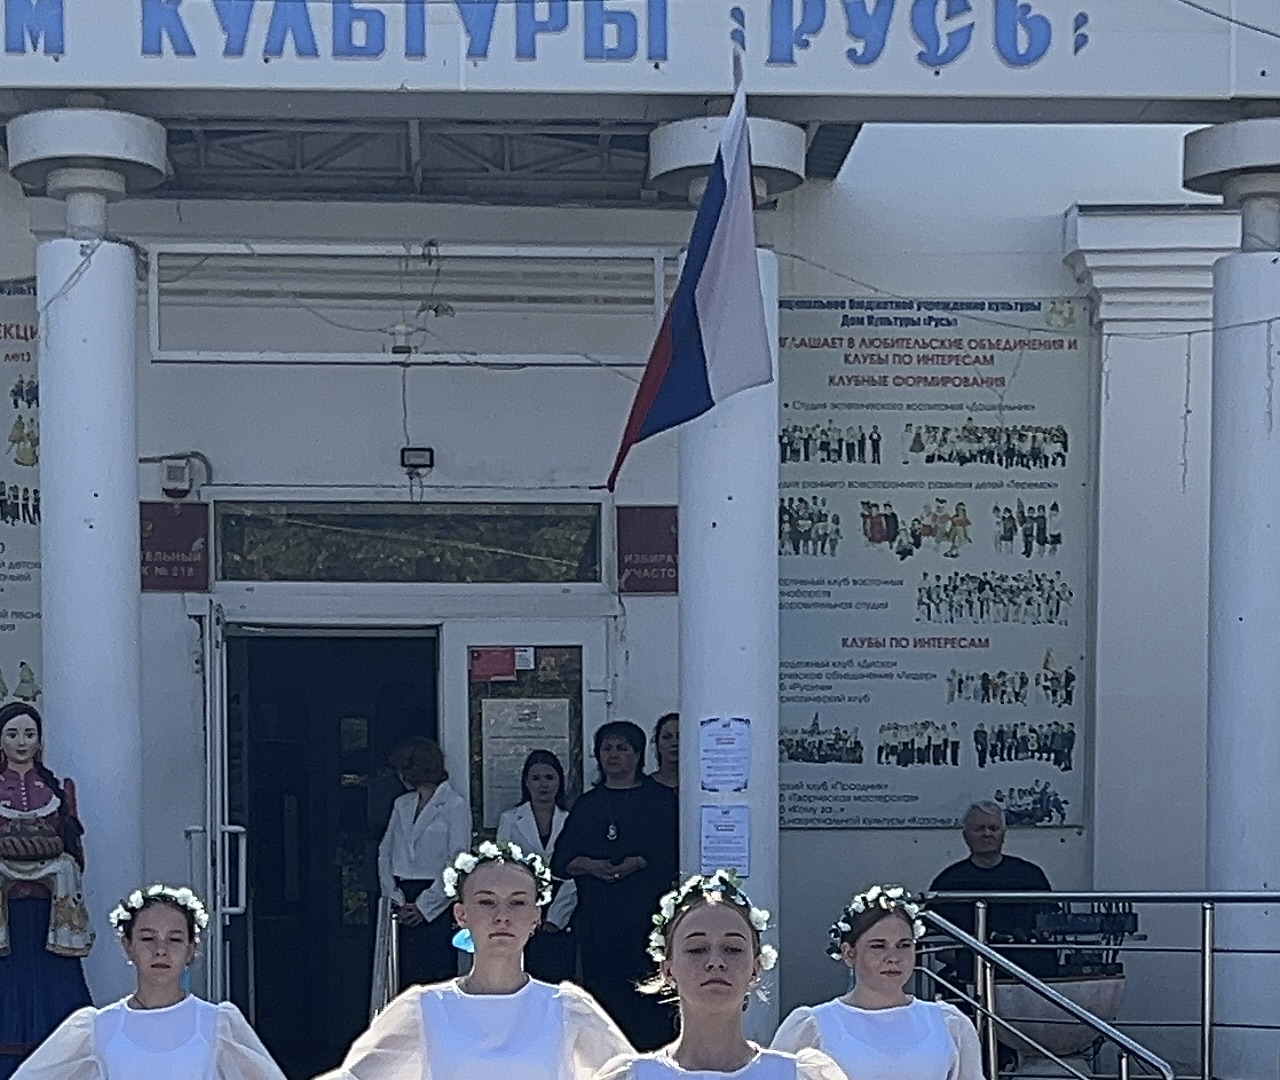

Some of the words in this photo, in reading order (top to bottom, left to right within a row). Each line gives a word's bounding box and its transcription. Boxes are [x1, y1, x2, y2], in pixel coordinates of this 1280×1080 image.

[145, 551, 200, 563] ЕЛЬНЫЙ
[842, 637, 886, 649] КЛУБЫ
[890, 637, 909, 649] ПО
[913, 637, 990, 649] ИНТЕРЕСАМ
